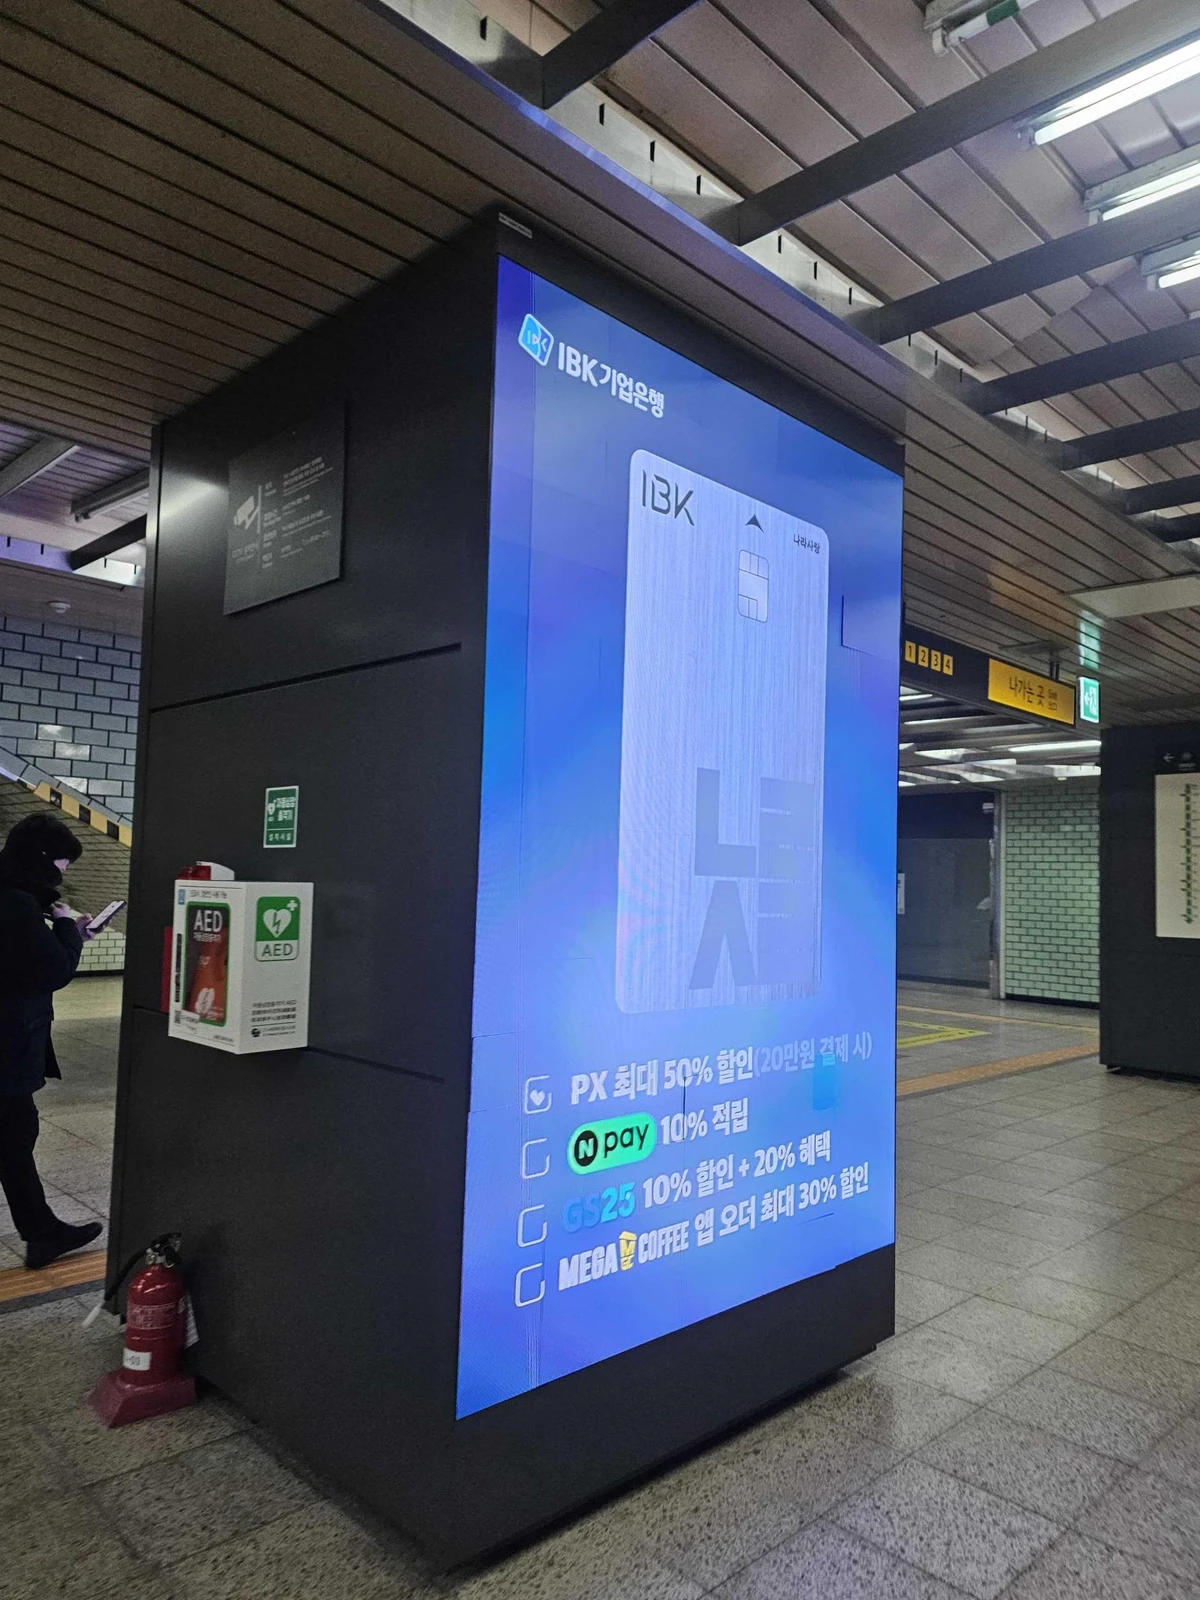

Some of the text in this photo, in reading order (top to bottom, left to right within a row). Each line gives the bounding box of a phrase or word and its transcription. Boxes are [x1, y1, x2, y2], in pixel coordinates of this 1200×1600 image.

[641, 469, 695, 527] IBK
[793, 534, 821, 554] 나라사랑
[1008, 676, 1046, 707] 나가는 곳
[193, 909, 223, 933] AED
[261, 943, 293, 958] AED
[571, 1070, 608, 1105] PX
[613, 1060, 659, 1100] 최대
[663, 1055, 714, 1090] 50%
[819, 1033, 849, 1064] 결제
[852, 1031, 873, 1061] 시)
[660, 1109, 709, 1146] 10%
[712, 1097, 749, 1136] 적립
[560, 1182, 636, 1233] GS25
[643, 1168, 693, 1209] 10%
[696, 1154, 734, 1198] 할인
[754, 1142, 796, 1178] 20%
[799, 1130, 831, 1166] 혜택
[558, 1243, 619, 1292] MEGA
[638, 1220, 690, 1265] COFFEE
[694, 1207, 715, 1247] 앱
[719, 1195, 756, 1237] 오더
[760, 1184, 795, 1223] 최대
[798, 1174, 837, 1210] 30%
[840, 1162, 869, 1200] 할인
